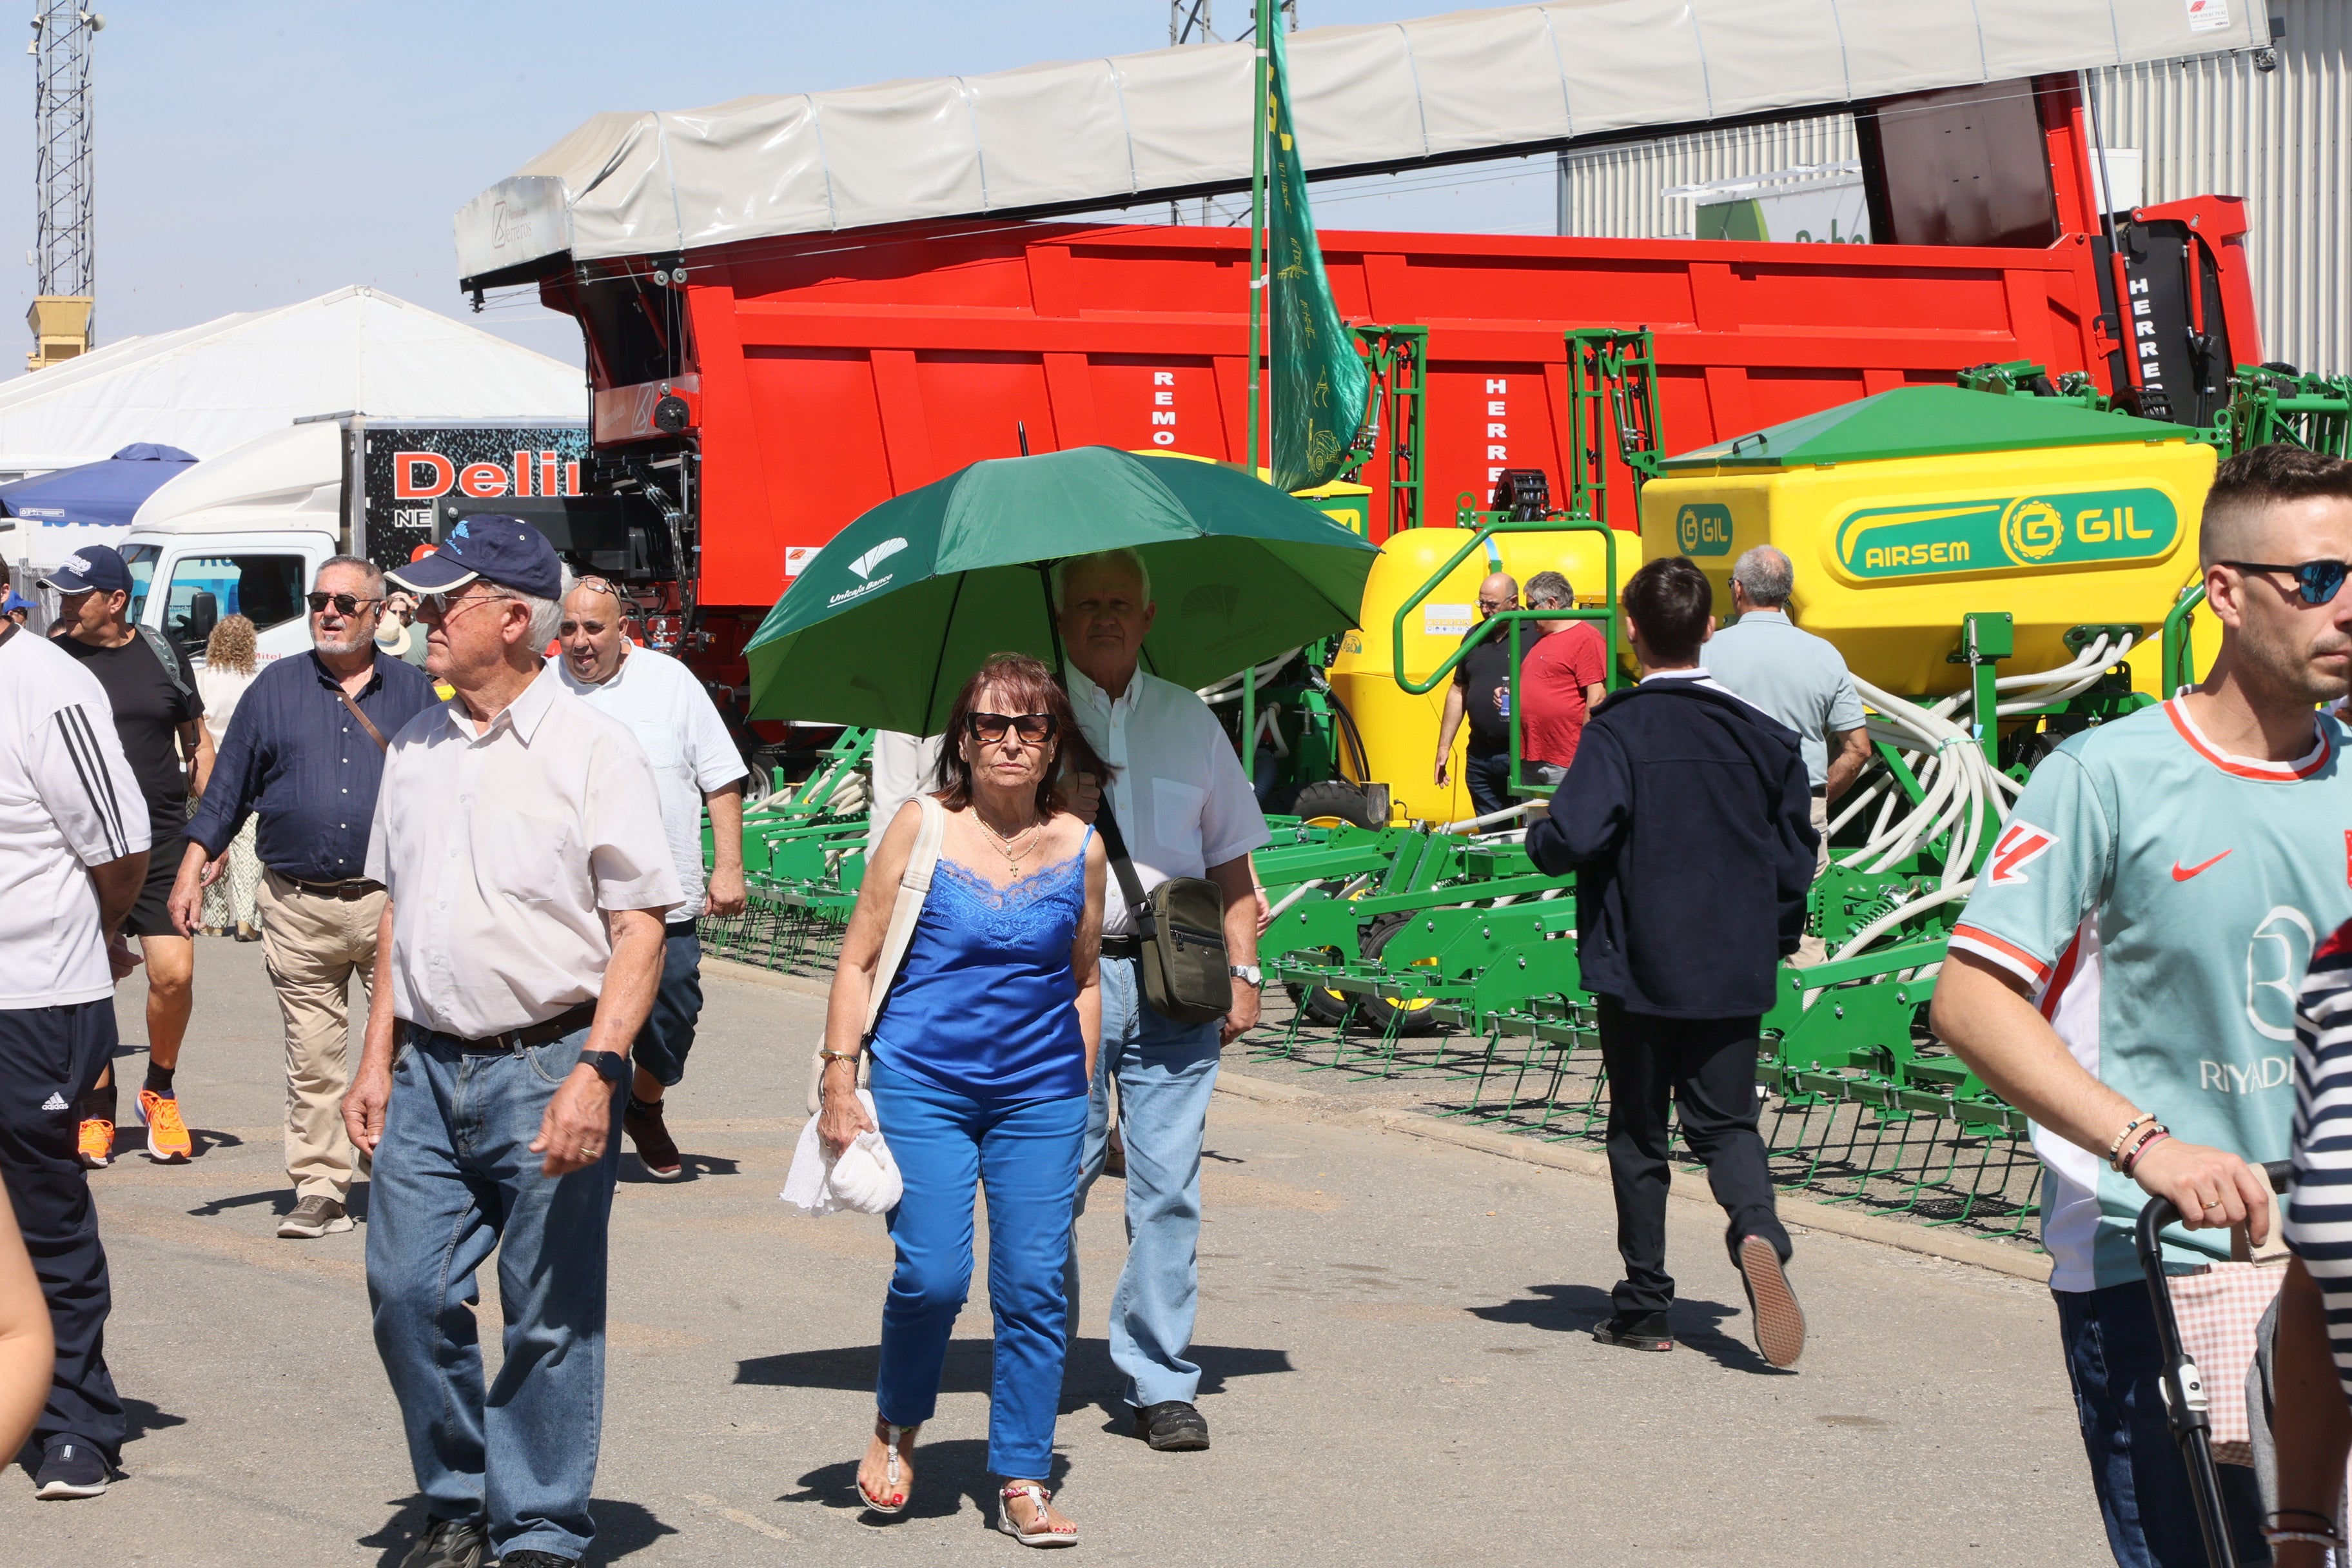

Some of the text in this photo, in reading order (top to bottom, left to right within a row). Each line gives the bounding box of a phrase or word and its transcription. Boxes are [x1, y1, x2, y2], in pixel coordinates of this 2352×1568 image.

[1152, 371, 1175, 445] REMO
[1702, 518, 1729, 542] GIL
[2076, 507, 2153, 542] GIL
[1865, 541, 1970, 569] AIRSEM
[829, 573, 893, 603] Unicaja Banco
